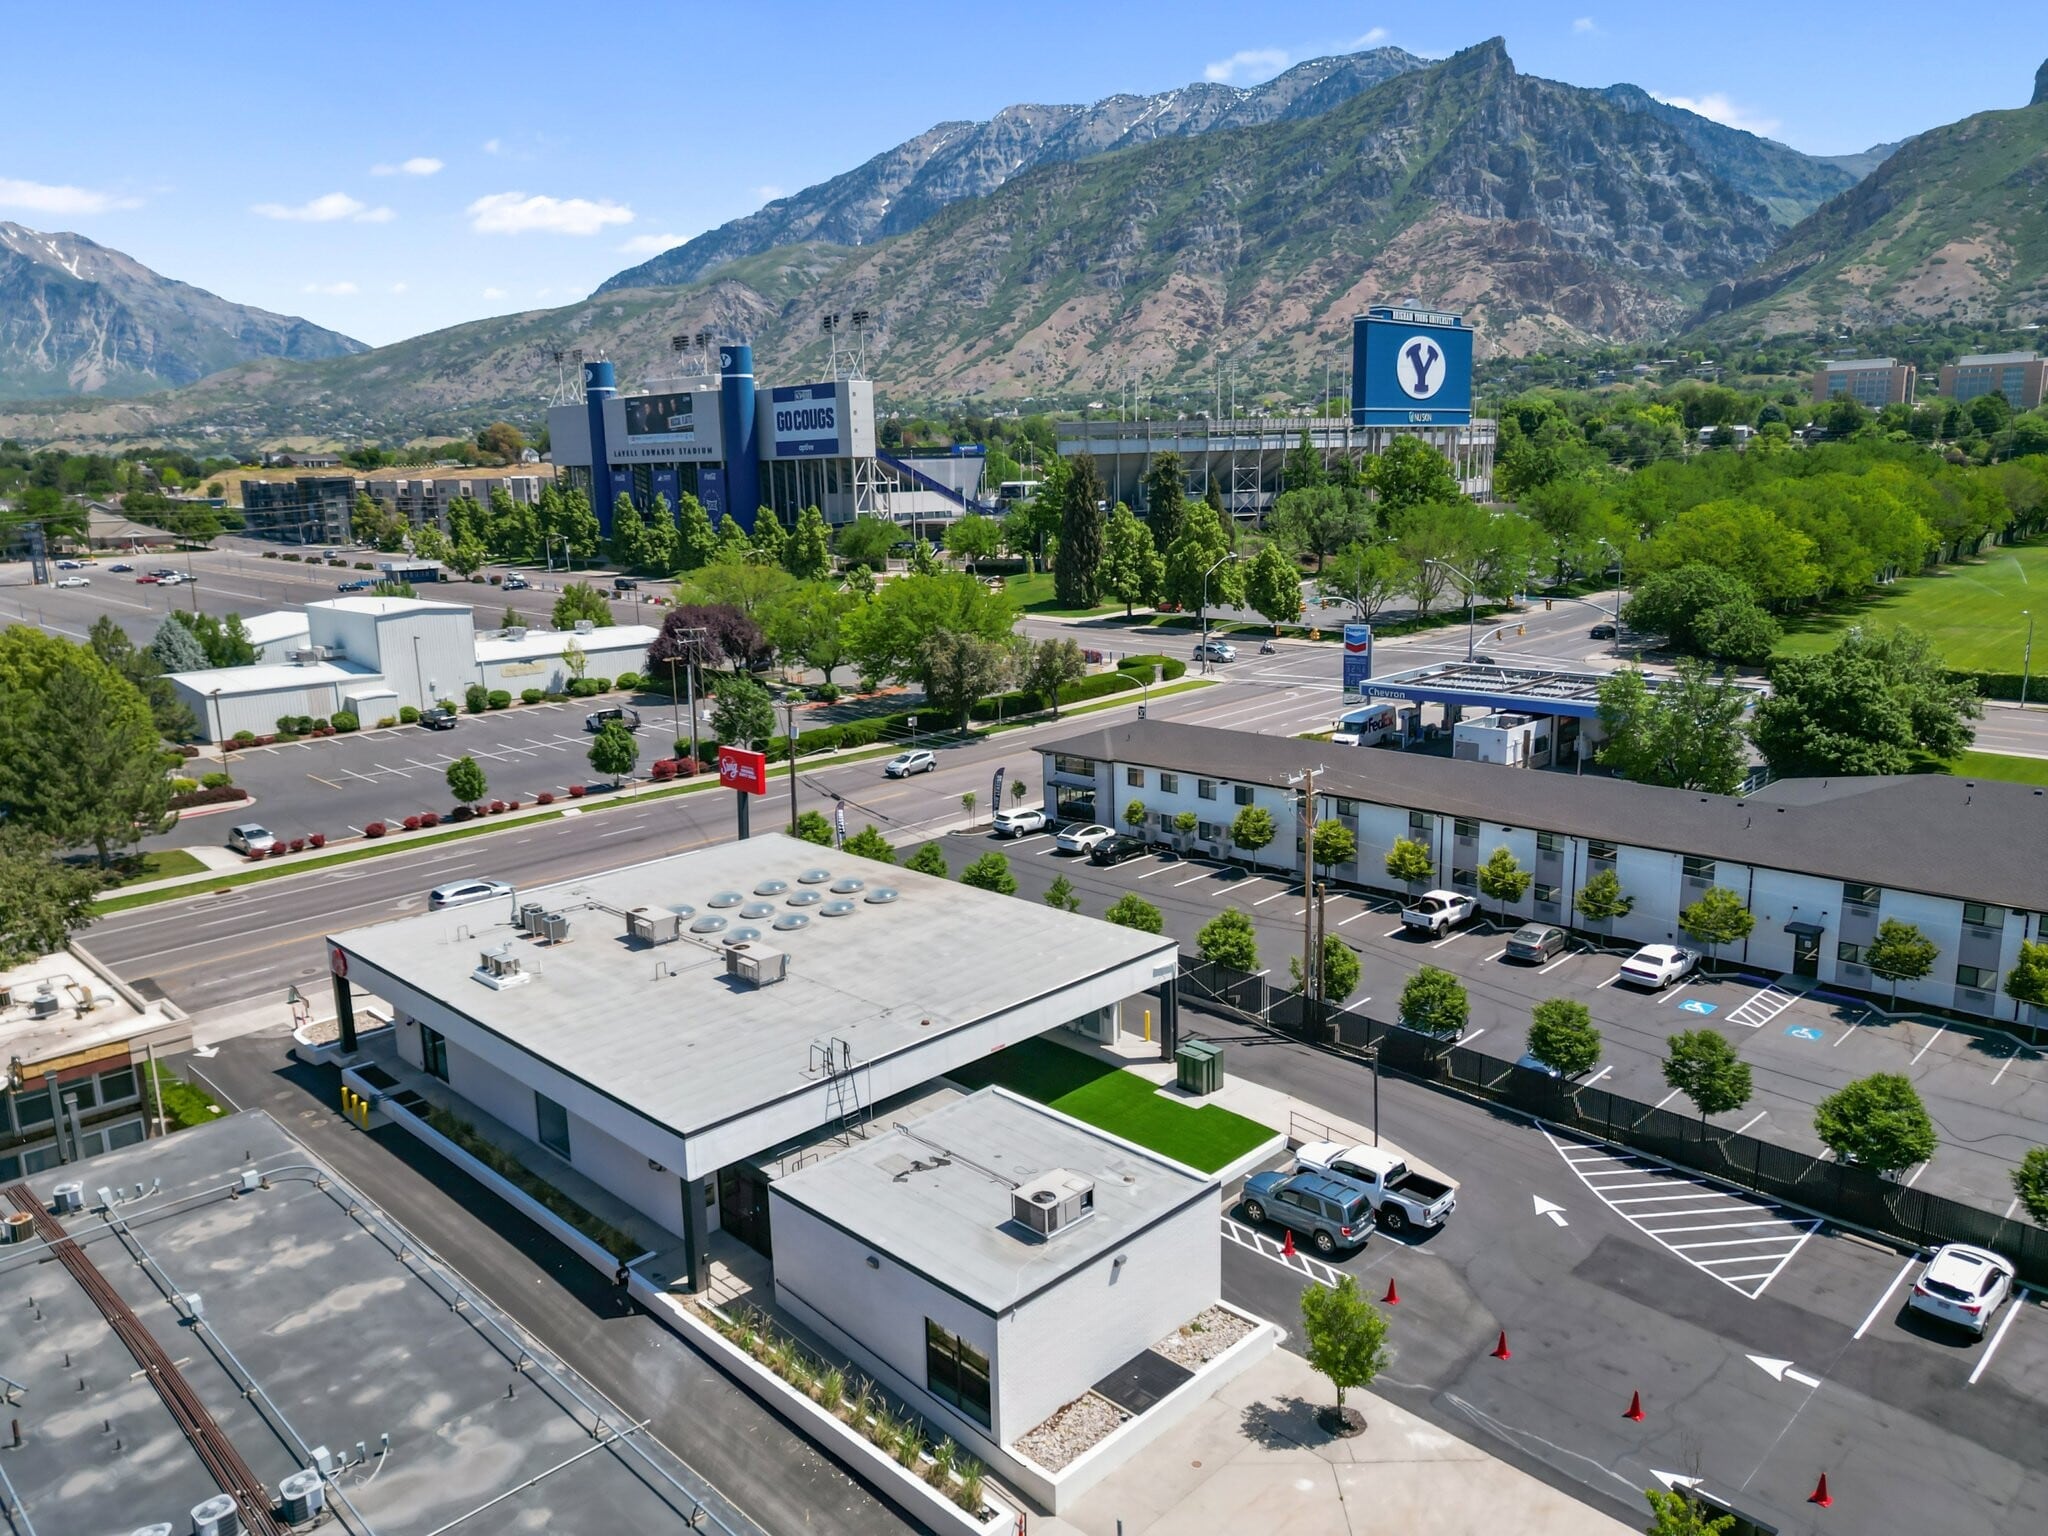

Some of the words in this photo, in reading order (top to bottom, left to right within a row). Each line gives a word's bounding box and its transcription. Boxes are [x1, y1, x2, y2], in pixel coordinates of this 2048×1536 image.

[1406, 343, 1439, 393] Y
[613, 449, 638, 457] LAVELL
[641, 447, 675, 457] EDWARDS
[679, 446, 713, 456] STADIUM
[1368, 687, 1406, 699] Chevron
[1368, 711, 1394, 734] FedEx
[720, 758, 739, 778] Swig
